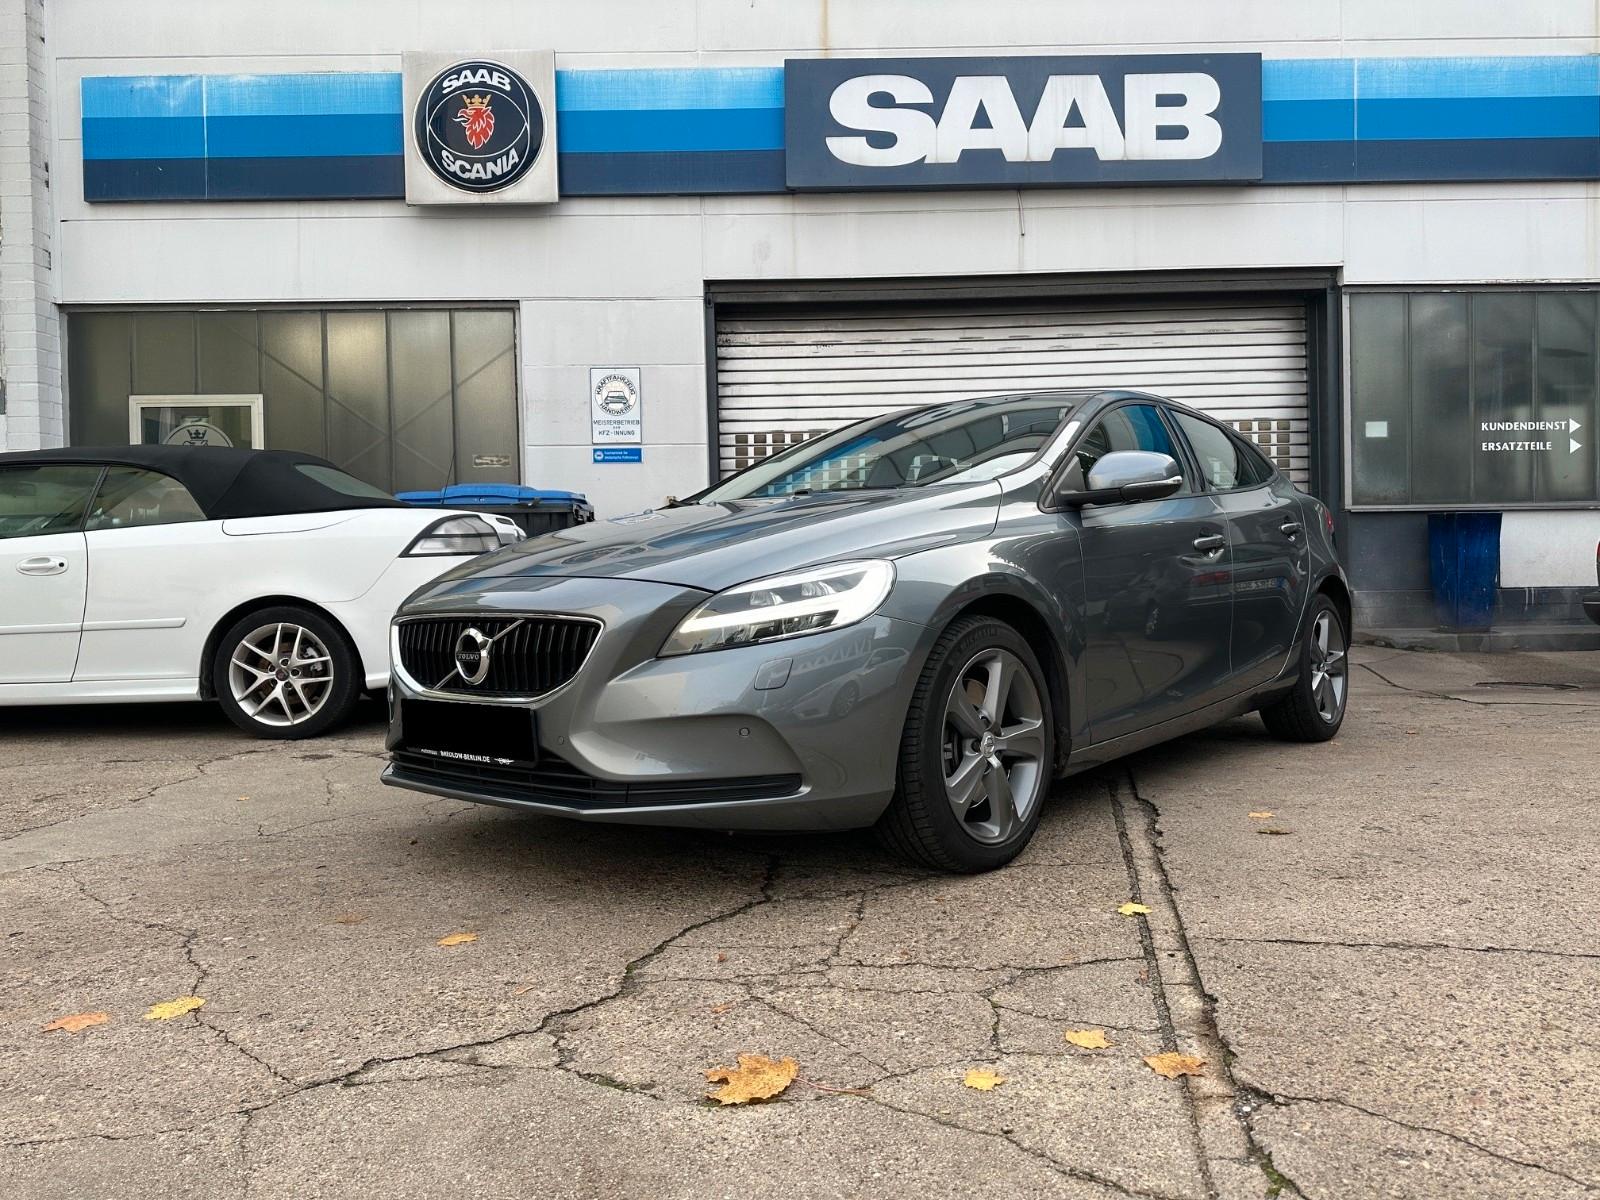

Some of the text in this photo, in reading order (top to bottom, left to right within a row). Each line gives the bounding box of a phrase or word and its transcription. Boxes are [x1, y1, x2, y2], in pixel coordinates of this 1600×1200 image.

[442, 68, 511, 94] SAAB
[825, 72, 1223, 167] SAAB
[441, 147, 519, 179] SCANIA
[1481, 421, 1567, 431] KUNDENDIENST
[1482, 441, 1552, 451] ERSATZTEILE
